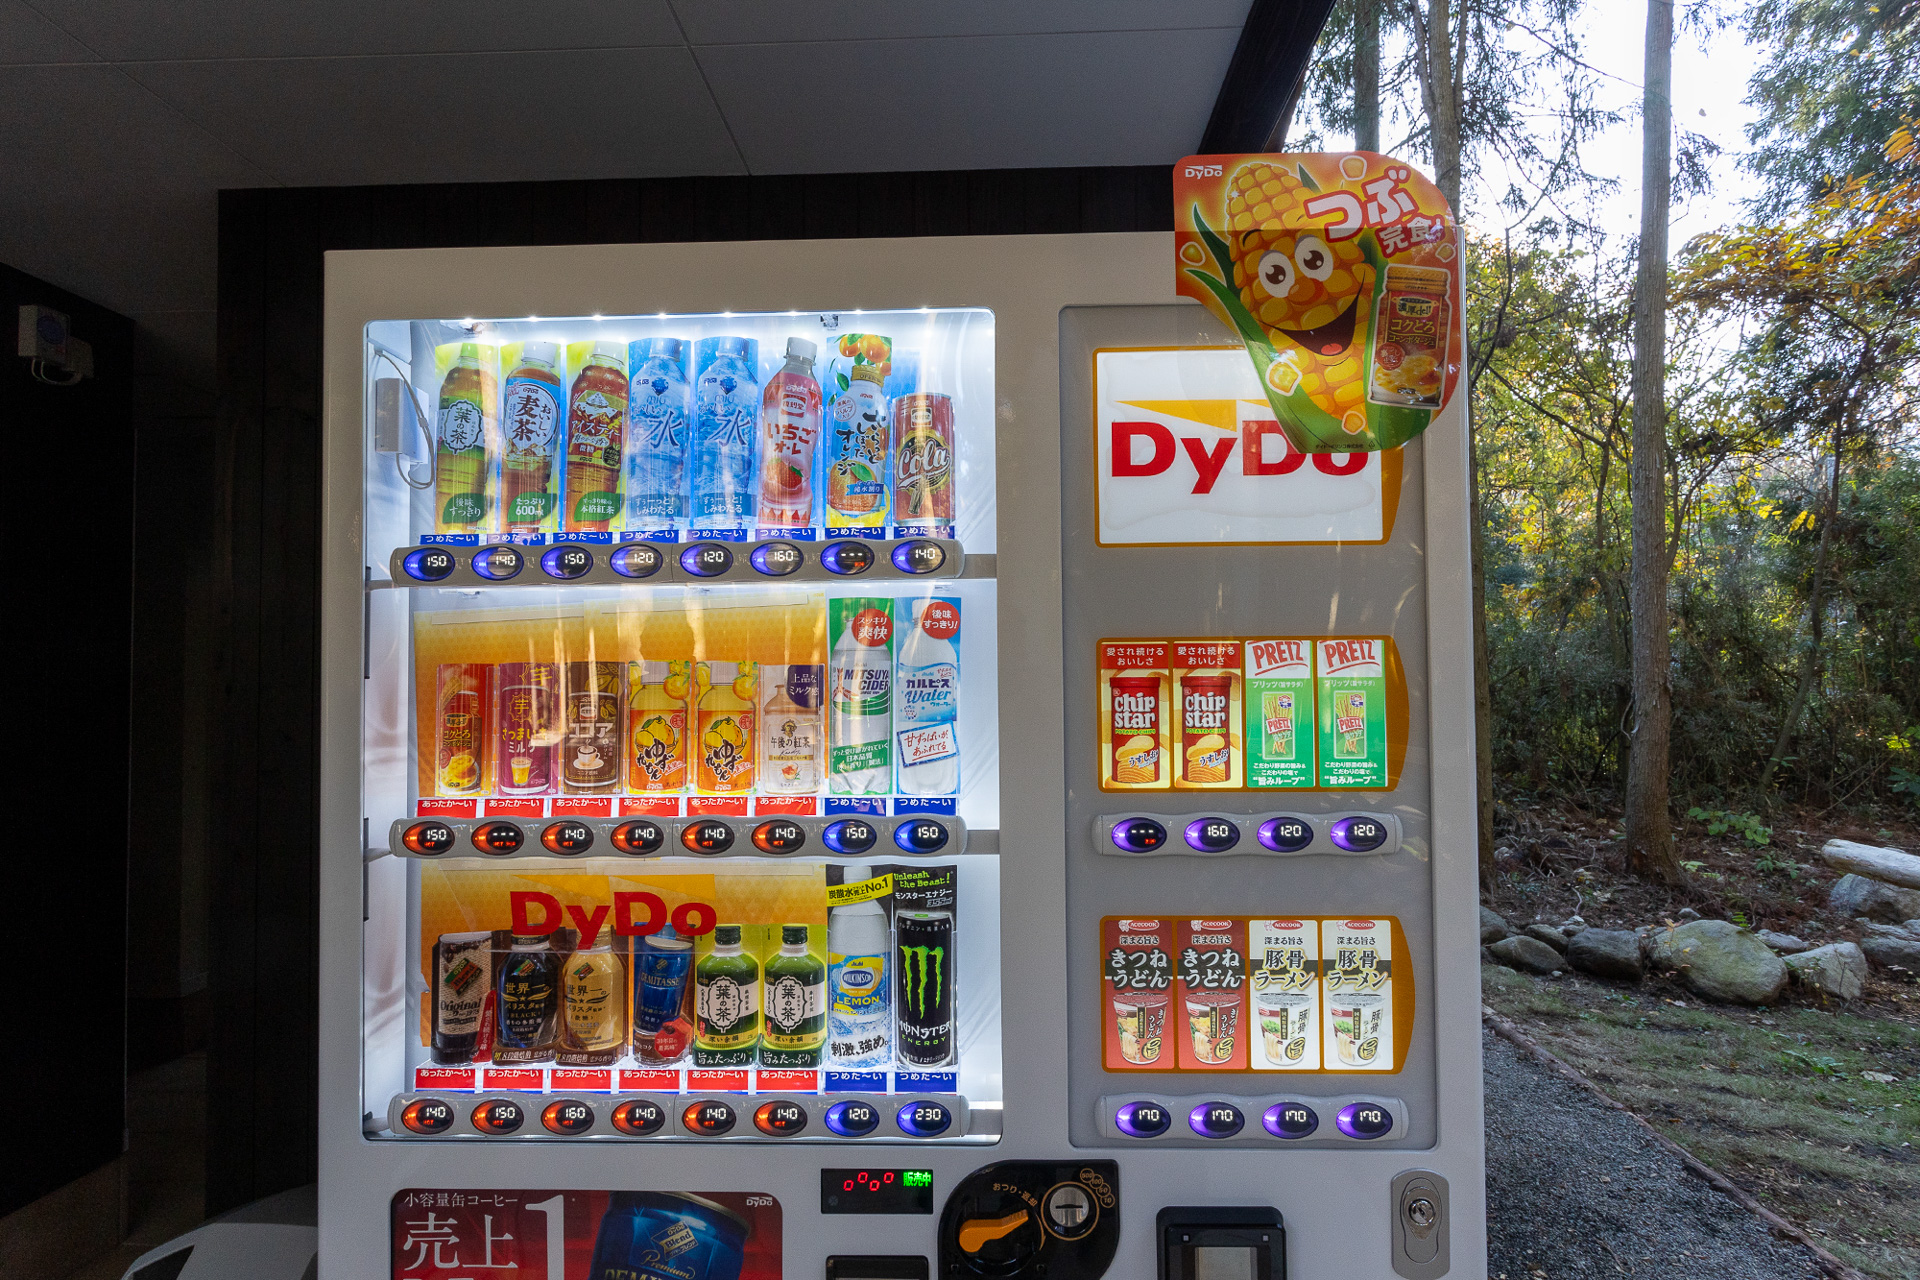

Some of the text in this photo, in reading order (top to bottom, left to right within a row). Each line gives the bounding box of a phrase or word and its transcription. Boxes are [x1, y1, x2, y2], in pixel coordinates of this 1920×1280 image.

[1185, 168, 1222, 179] DyDo
[1308, 170, 1414, 239] つぶ
[1391, 319, 1435, 334] コクとろ
[1389, 335, 1435, 345] コーンポタージュ
[513, 395, 540, 441] 麦茶
[536, 404, 551, 437] おいしい
[450, 407, 472, 444] 葉の茶
[572, 421, 620, 438] アイスティー
[641, 410, 683, 449] 水
[708, 409, 751, 446] 水
[767, 424, 817, 445] いちご
[836, 429, 855, 475] オレンジ
[898, 439, 951, 479] Cola
[449, 507, 481, 517] すっきり
[581, 505, 615, 514] 本格紅茶
[637, 505, 674, 514] しみわたる
[704, 504, 742, 513] しみわたる
[565, 553, 584, 565] 150
[634, 552, 654, 563] 120
[704, 551, 724, 562] 120
[774, 550, 794, 561] 160
[915, 548, 935, 559] 140
[427, 556, 447, 567] 150
[495, 555, 515, 566] 140
[932, 609, 951, 619] 後味
[857, 617, 887, 625] スッキリ
[924, 620, 958, 629] すっきり!
[859, 626, 888, 640] 爽快
[1107, 648, 1164, 656] 愛され続ける
[1178, 647, 1235, 655] 愛され続ける
[1252, 640, 1303, 669] PRETZ
[1324, 640, 1375, 669] PRETZ
[1117, 658, 1154, 666] おいしさ
[1188, 657, 1225, 665] おいしさ
[530, 667, 552, 686] 芋
[794, 674, 817, 683] 上品な
[858, 680, 889, 691] CIDER
[906, 679, 951, 688] カルピス
[905, 690, 951, 704] Water
[1114, 692, 1156, 712] chip
[1185, 692, 1227, 712] chip
[514, 699, 529, 714] 芋
[1114, 711, 1156, 728] star
[1185, 710, 1227, 728] star
[1339, 718, 1362, 731] PRETZ
[569, 723, 613, 738] ココア
[1268, 719, 1291, 732] PRETZ
[444, 730, 470, 738] コクとろ
[771, 736, 811, 748] 午後の紅茶
[913, 742, 947, 757] あふれてる
[847, 753, 873, 762] 日本品質
[427, 830, 447, 841] 150
[565, 829, 585, 839] 140
[634, 828, 654, 839] 140
[705, 828, 725, 839] 140
[775, 828, 796, 838] 140
[847, 828, 867, 838] 150
[918, 827, 938, 838] 150
[1207, 826, 1228, 837] 160
[1281, 826, 1301, 836] 120
[1354, 825, 1374, 836] 120
[894, 871, 930, 881] Unleash
[917, 872, 950, 887] Beast!
[828, 888, 854, 899] 炭酸水
[895, 889, 952, 899] モンスターエナジー
[510, 891, 717, 950] DyDo
[1120, 936, 1159, 945] 深まる旨さ
[1193, 936, 1232, 945] 深まる旨さ
[1264, 937, 1303, 945] 深まる旨さ
[1337, 937, 1376, 945] 深まる旨さ
[1111, 949, 1167, 967] きつね
[1183, 949, 1239, 967] きつね
[1265, 950, 1304, 968] 豚骨
[1337, 950, 1377, 968] 豚骨
[844, 974, 872, 983] WILKINSON
[1114, 969, 1168, 988] うどん
[1186, 969, 1240, 988] うどん
[1256, 972, 1314, 988] ラーメン
[1329, 972, 1387, 988] ラーメン
[716, 984, 731, 1023] 葉の茶
[781, 985, 796, 1022] 葉の茶
[837, 996, 879, 1005] LEMON
[426, 1107, 446, 1117] 140
[496, 1107, 515, 1118] 150
[566, 1107, 586, 1118] 160
[635, 1108, 655, 1119] 140
[706, 1109, 726, 1119] 140
[777, 1108, 797, 1119] 140
[849, 1109, 869, 1120] 120
[916, 1109, 941, 1120] 230
[1138, 1110, 1159, 1121] 170
[1212, 1110, 1232, 1121] 170
[1286, 1111, 1306, 1122] 170
[1360, 1111, 1380, 1122] 170
[903, 1172, 932, 1187] 販売中
[404, 1193, 518, 1208] 小容量缶コーヒー
[746, 1199, 772, 1207] DyDo
[403, 1212, 518, 1271] 売上
[664, 1230, 692, 1249] Blend
[641, 1249, 695, 1280] Premium
